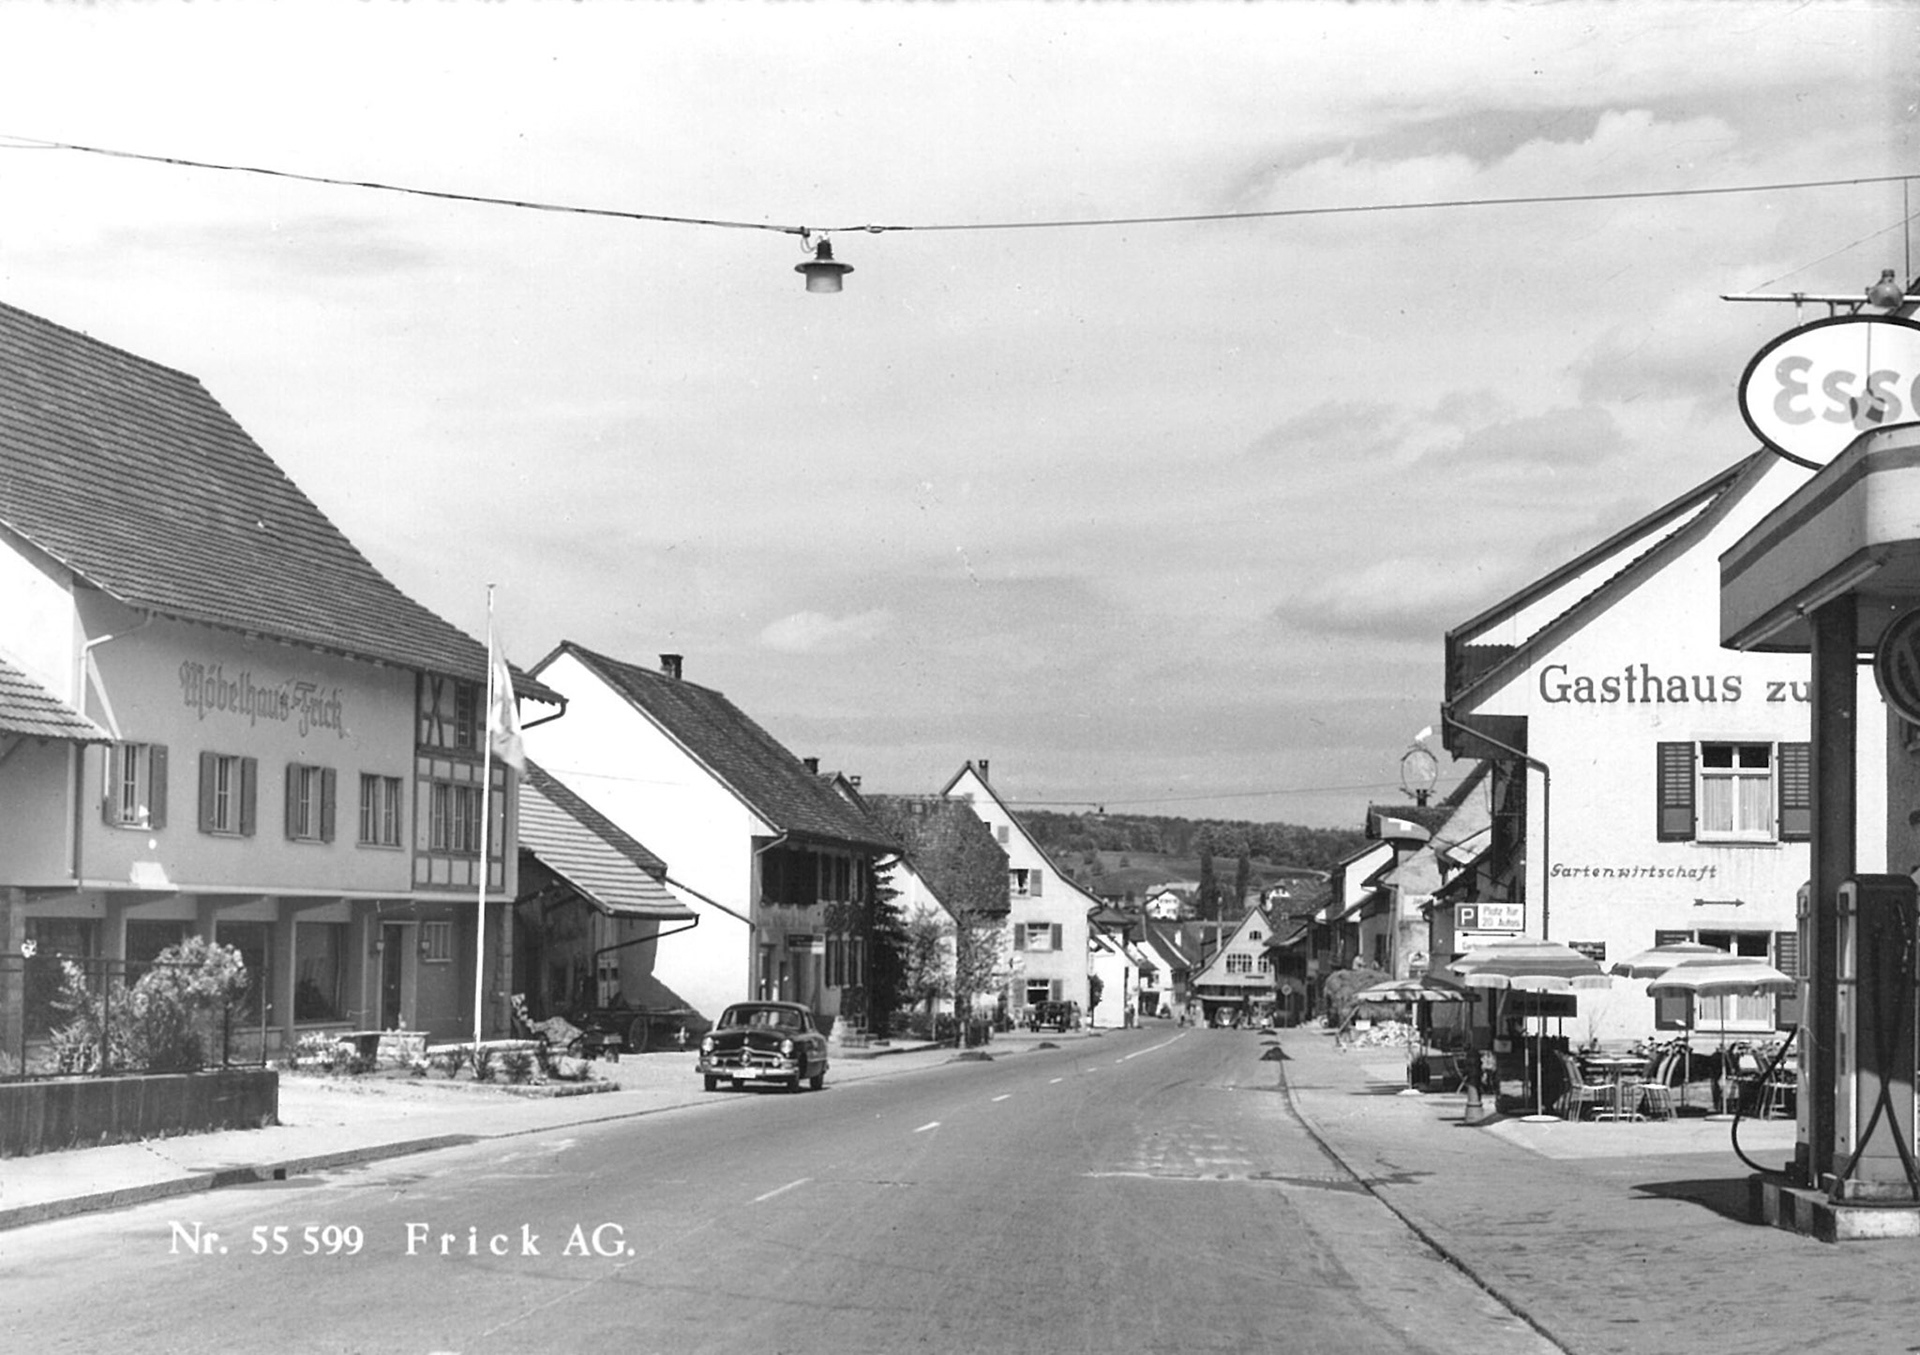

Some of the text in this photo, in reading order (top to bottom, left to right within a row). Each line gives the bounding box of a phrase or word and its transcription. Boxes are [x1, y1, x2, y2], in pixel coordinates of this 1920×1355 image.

[1773, 356, 1920, 425] Ess
[1539, 663, 1743, 704] Gasthaus
[1550, 863, 1717, 881] Gartenwirtschaft
[1461, 907, 1475, 926] P
